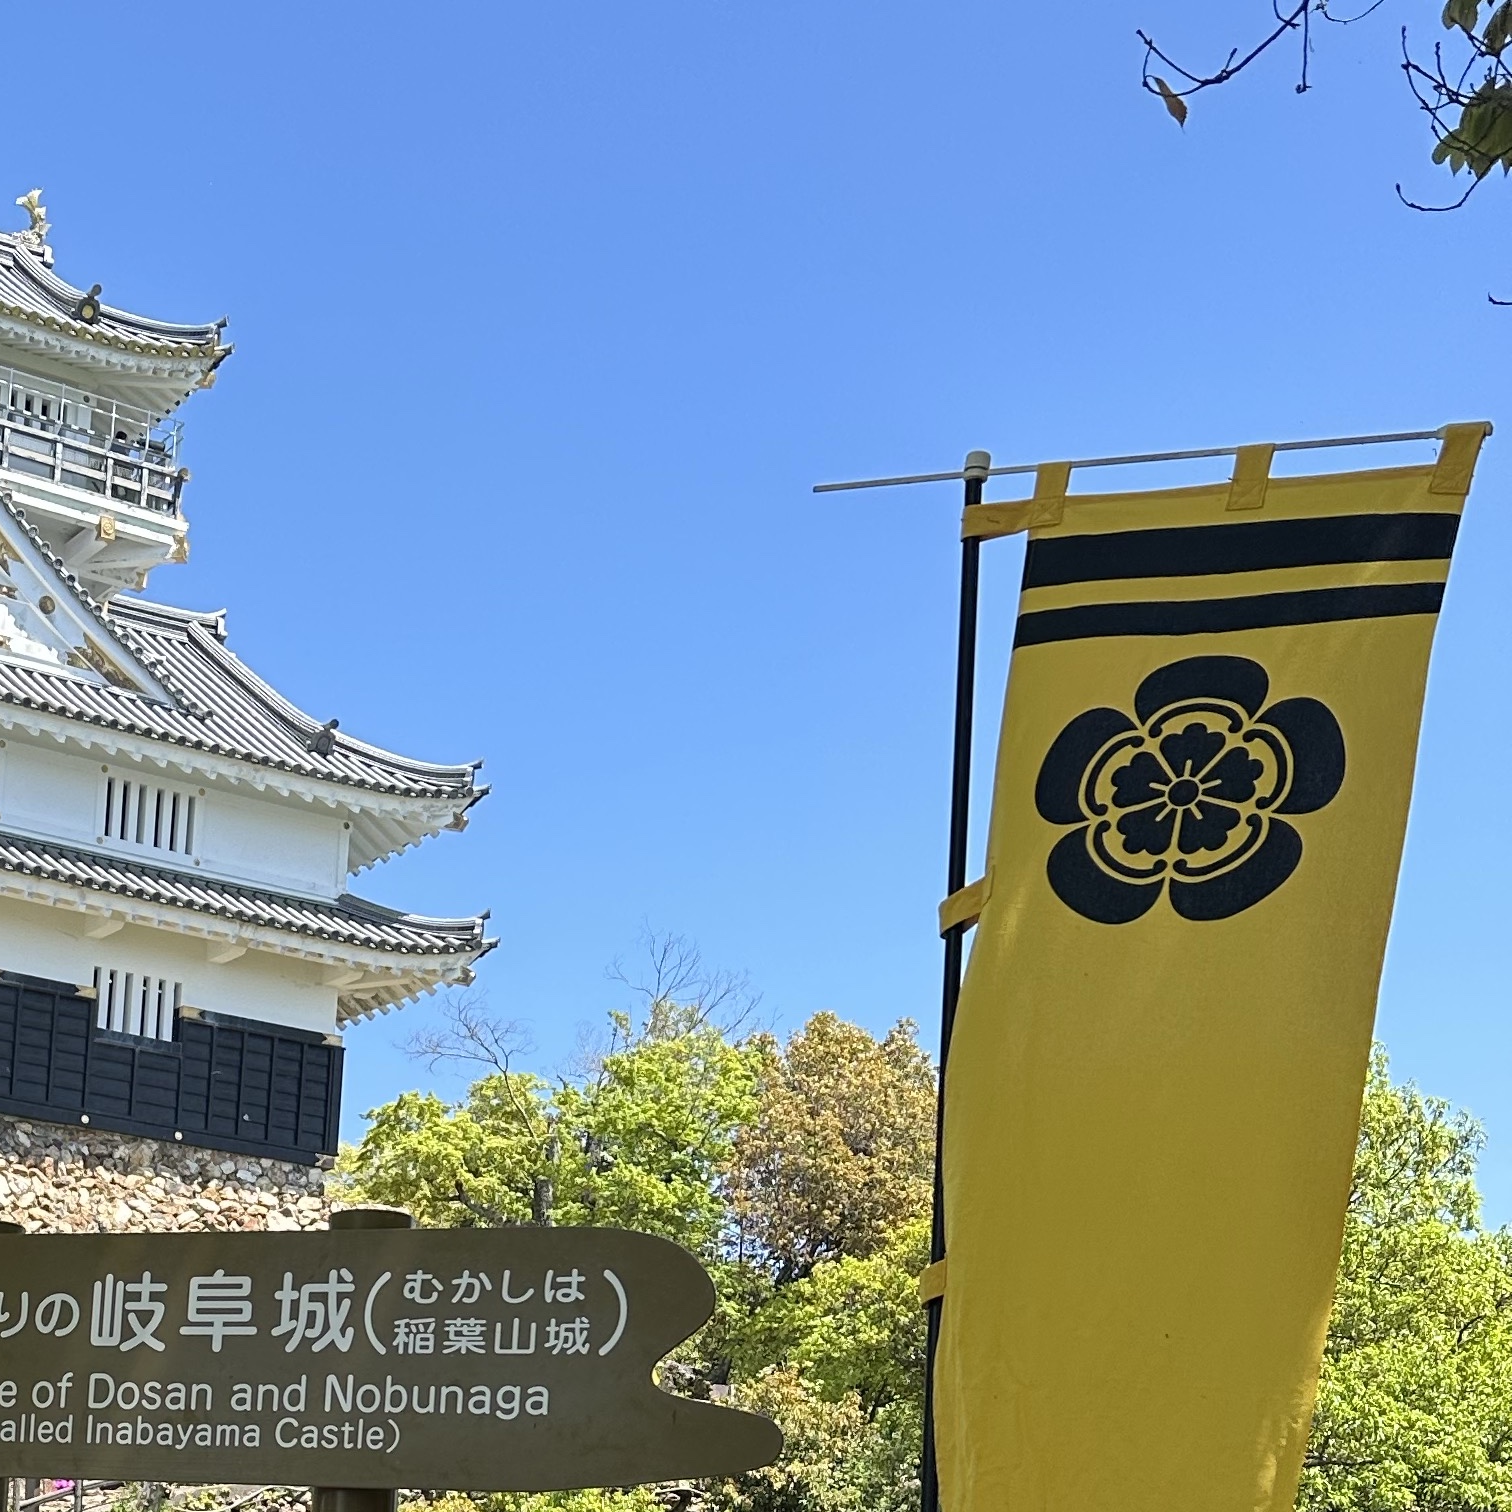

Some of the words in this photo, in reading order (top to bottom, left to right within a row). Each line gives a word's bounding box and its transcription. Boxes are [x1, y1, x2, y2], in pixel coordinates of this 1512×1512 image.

[32, 1371, 74, 1409] of
[88, 1372, 213, 1411] Dosan
[230, 1374, 307, 1412] and
[324, 1374, 549, 1420] Nobunaga
[86, 1414, 260, 1450] Inabayama
[275, 1417, 400, 1453] Castle)
